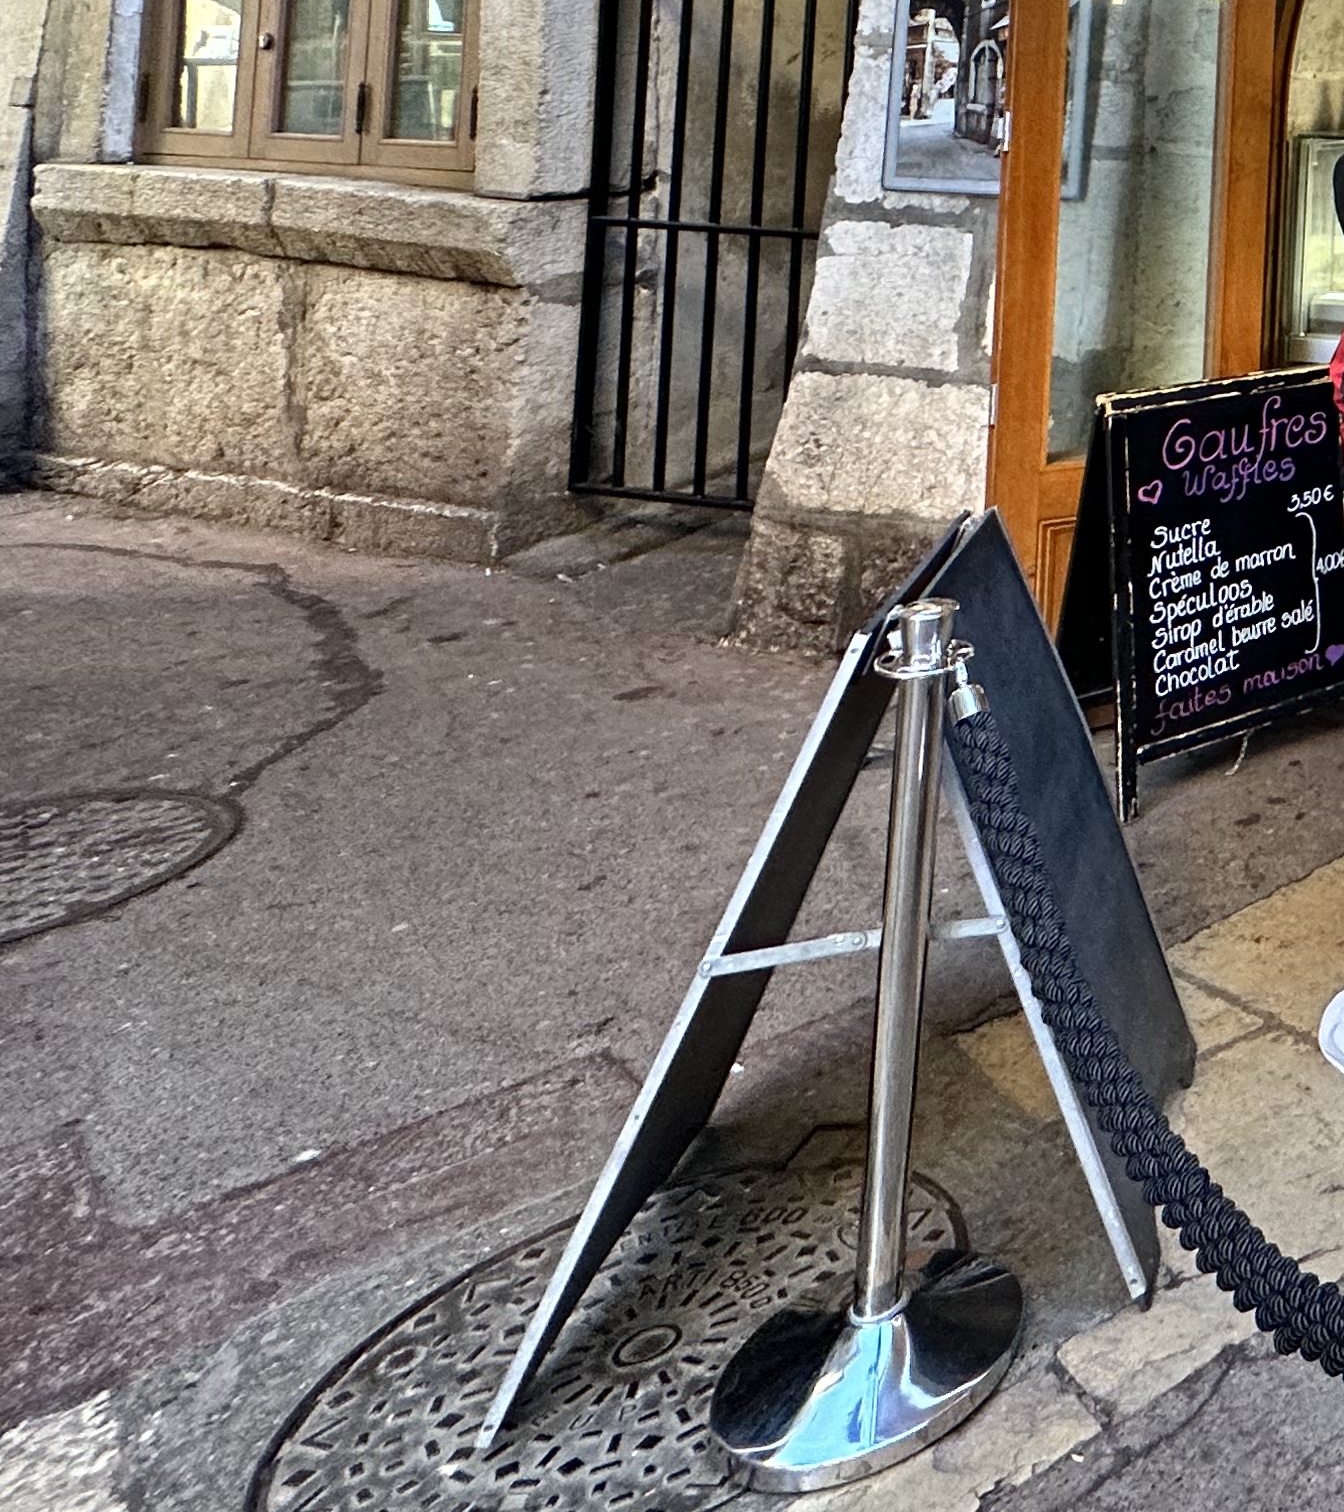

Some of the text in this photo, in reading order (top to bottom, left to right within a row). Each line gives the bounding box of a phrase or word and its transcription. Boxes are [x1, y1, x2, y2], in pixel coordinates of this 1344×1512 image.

[1162, 395, 1328, 471] Gaufres
[1182, 455, 1296, 503] Waffles
[1147, 538, 1221, 578] Nutella
[1150, 518, 1212, 549] Sucre
[1149, 542, 1297, 600] Crème de marron
[1150, 579, 1253, 628] Spéculoos
[1151, 591, 1275, 651] Sirop d'érable
[1153, 599, 1316, 674] Caramel beurre salé
[1150, 651, 1325, 736] faites maison
[1155, 650, 1240, 698] Chocolat
